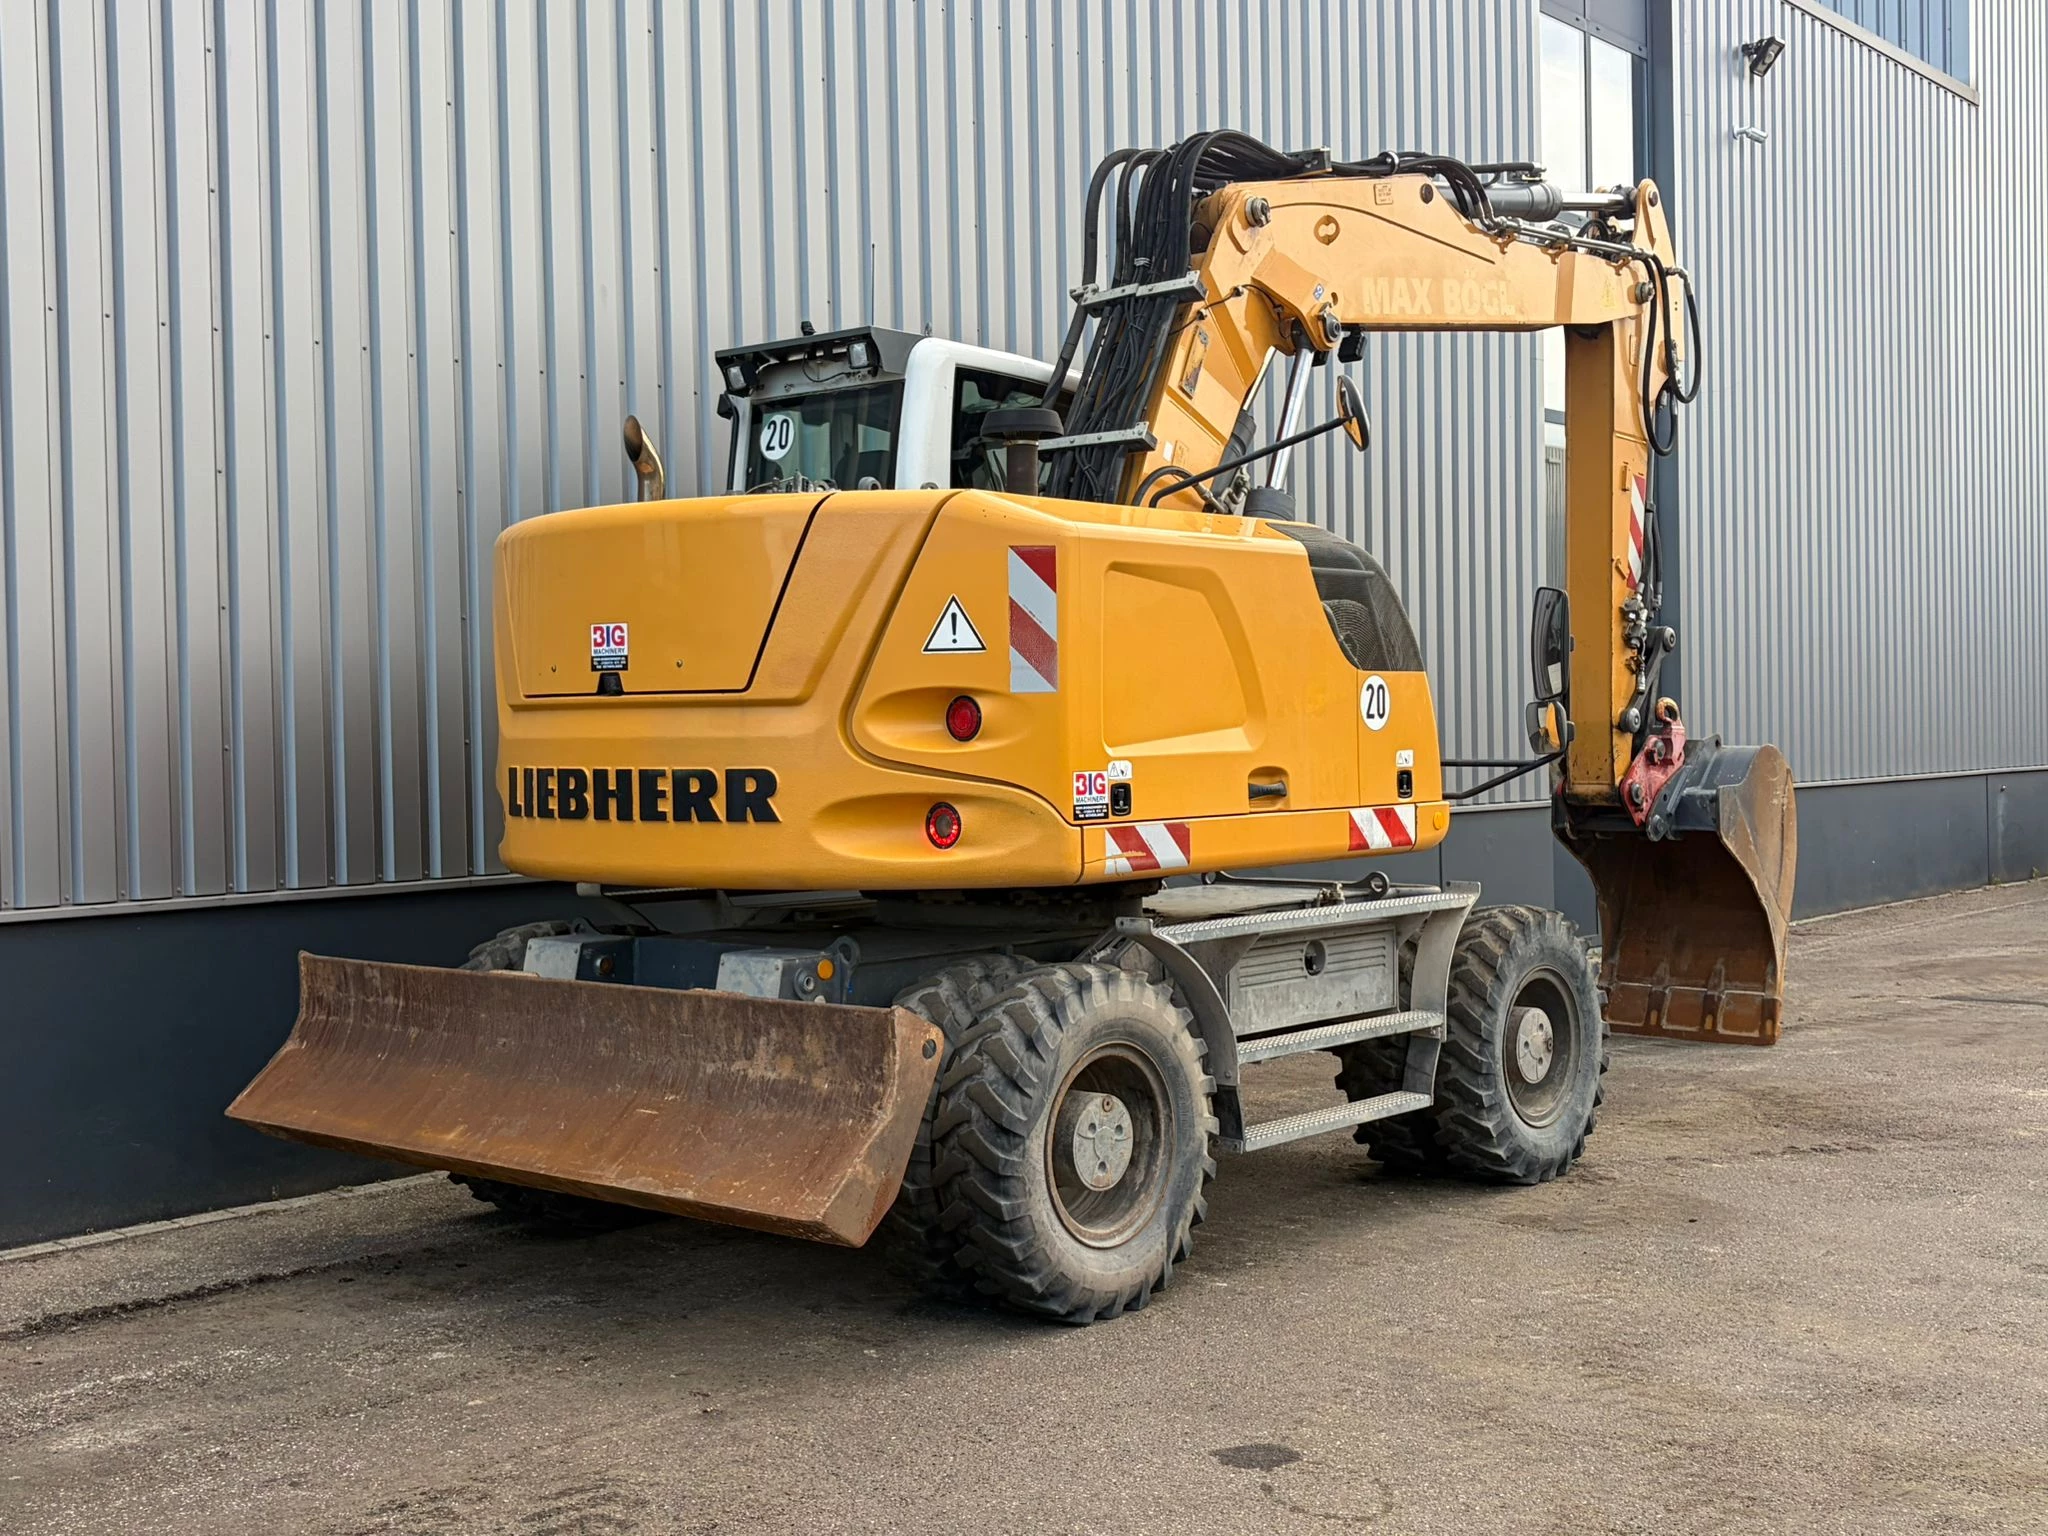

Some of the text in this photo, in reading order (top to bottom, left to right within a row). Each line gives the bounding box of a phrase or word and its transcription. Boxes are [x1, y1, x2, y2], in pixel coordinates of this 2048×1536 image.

[1361, 276, 1433, 316] MAX
[765, 418, 790, 451] 20
[1366, 683, 1386, 719] 20
[507, 766, 783, 823] LIEBHERR
